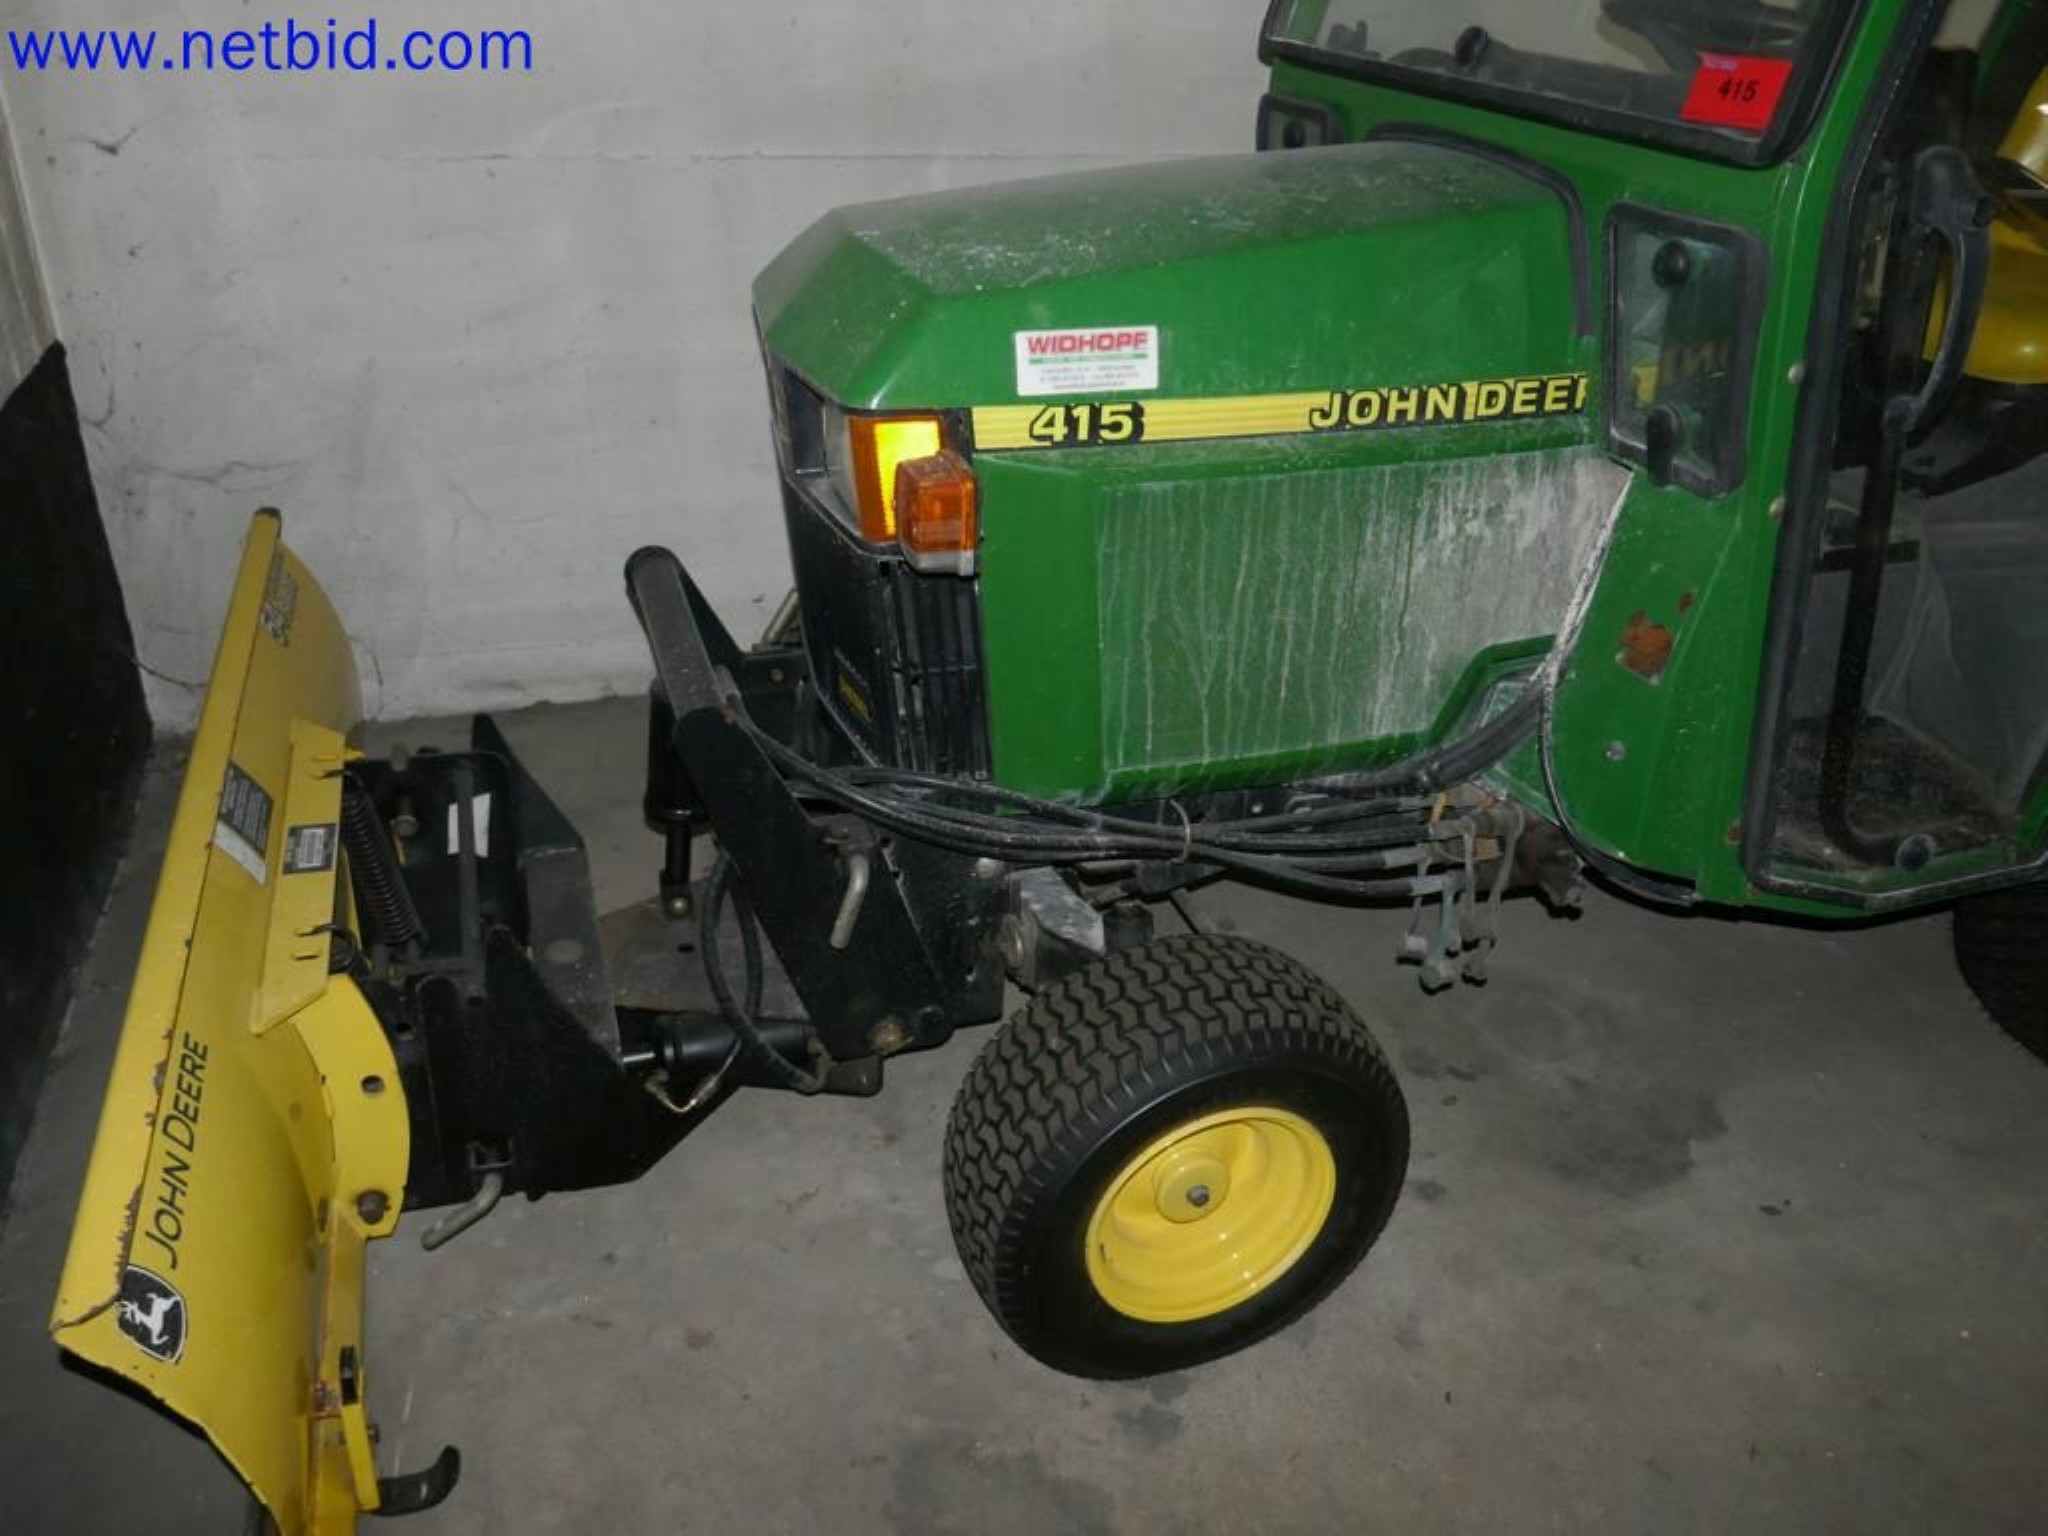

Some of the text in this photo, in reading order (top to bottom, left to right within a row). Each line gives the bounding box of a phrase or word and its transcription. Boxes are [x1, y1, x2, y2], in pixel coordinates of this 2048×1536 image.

[1717, 77, 1760, 103] 415
[1026, 332, 1148, 354] WIDHOPF
[1030, 402, 1140, 445] 415
[1309, 385, 1462, 430] JOHN
[145, 1031, 209, 1270] JOHN DEERE
